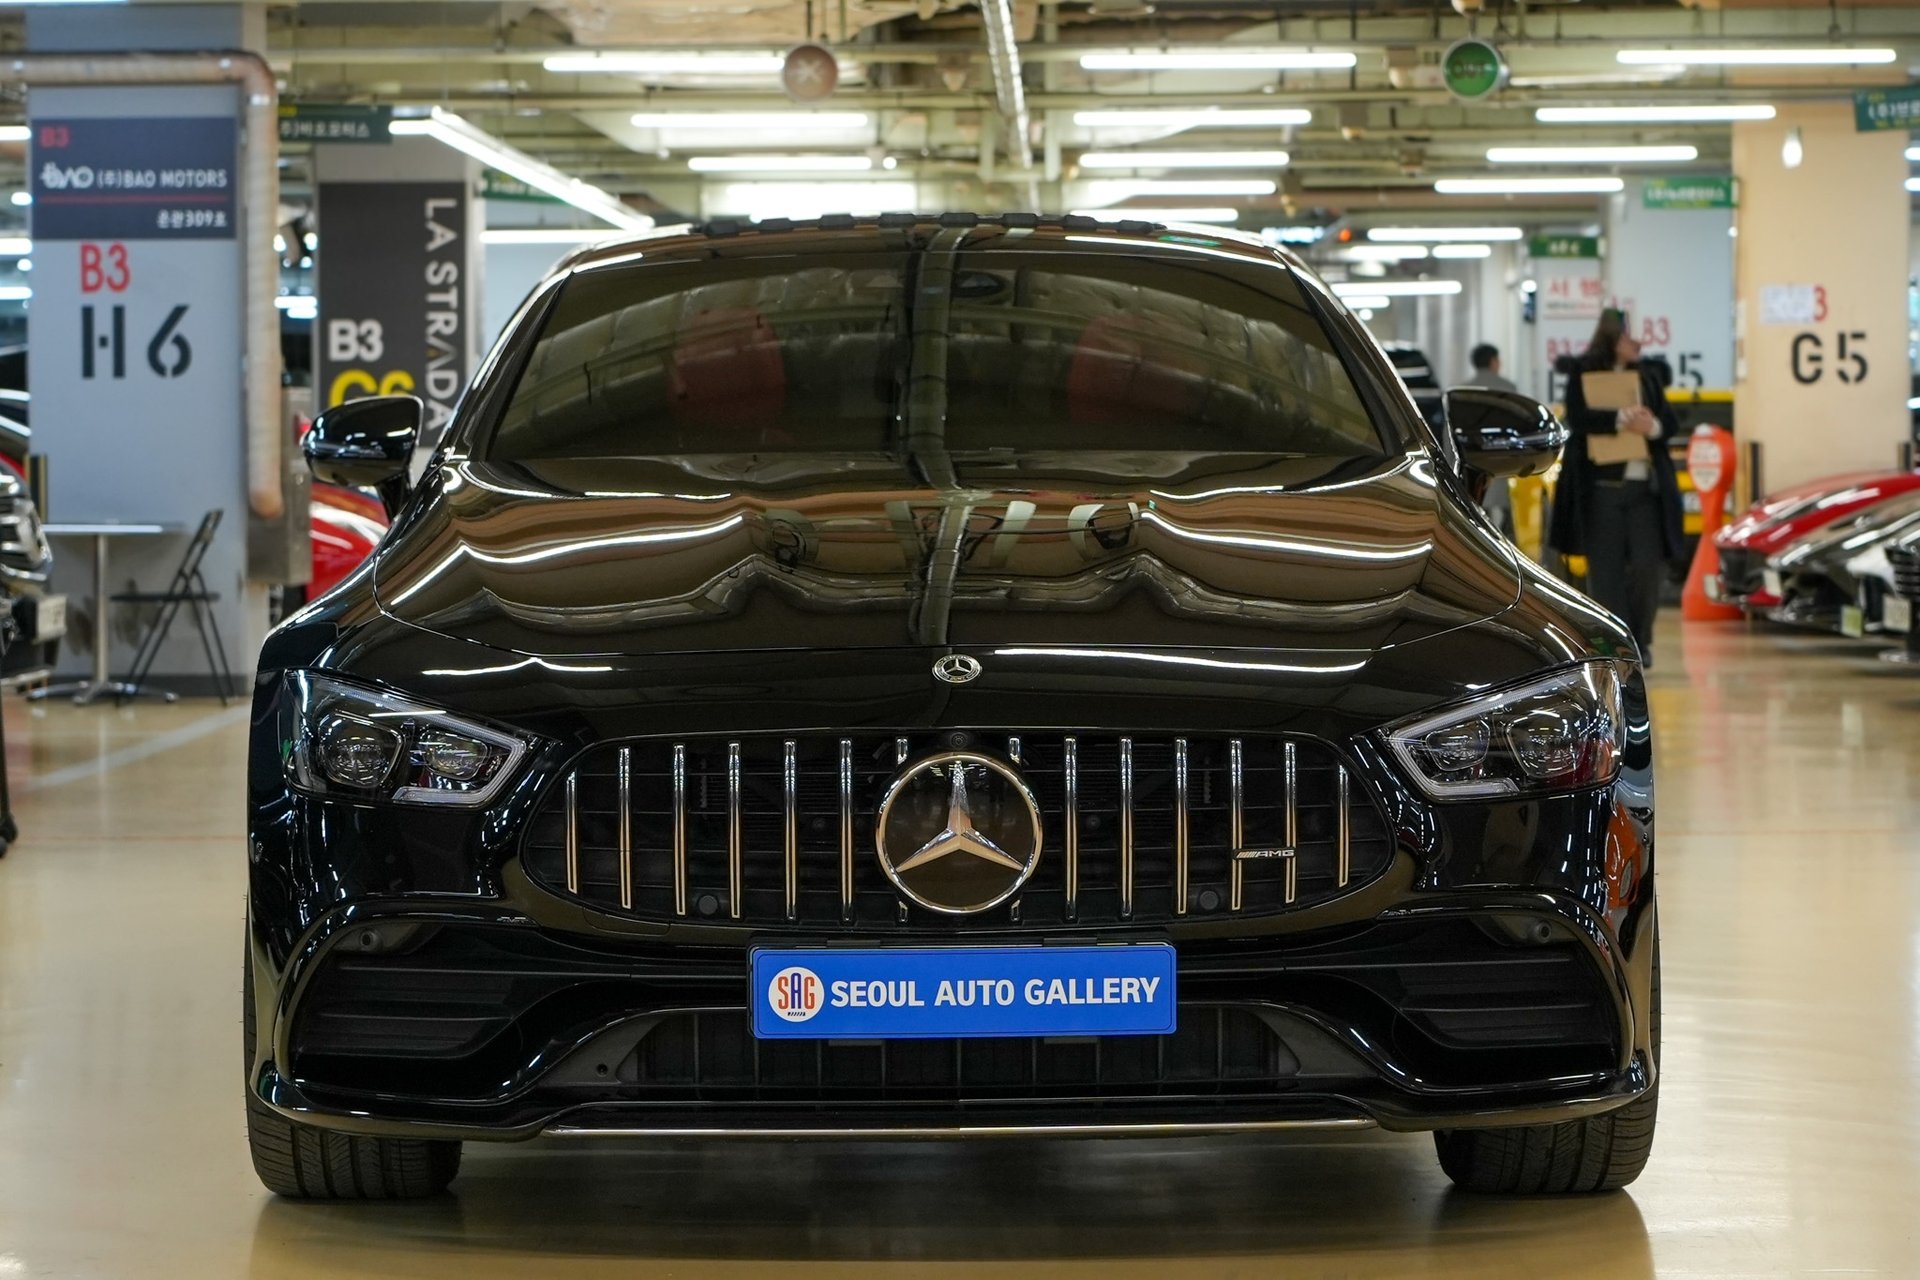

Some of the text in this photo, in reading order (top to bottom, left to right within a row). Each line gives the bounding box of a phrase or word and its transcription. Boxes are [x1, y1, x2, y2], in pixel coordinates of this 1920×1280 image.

[40, 127, 69, 148] B3
[160, 168, 228, 188] MOTORS
[81, 241, 131, 294] B3
[425, 199, 459, 430] LA STRADA
[1814, 286, 1829, 322] 3
[328, 319, 384, 362] B3
[777, 972, 1161, 1010] SAG SEOUL AUTO GALLERY
